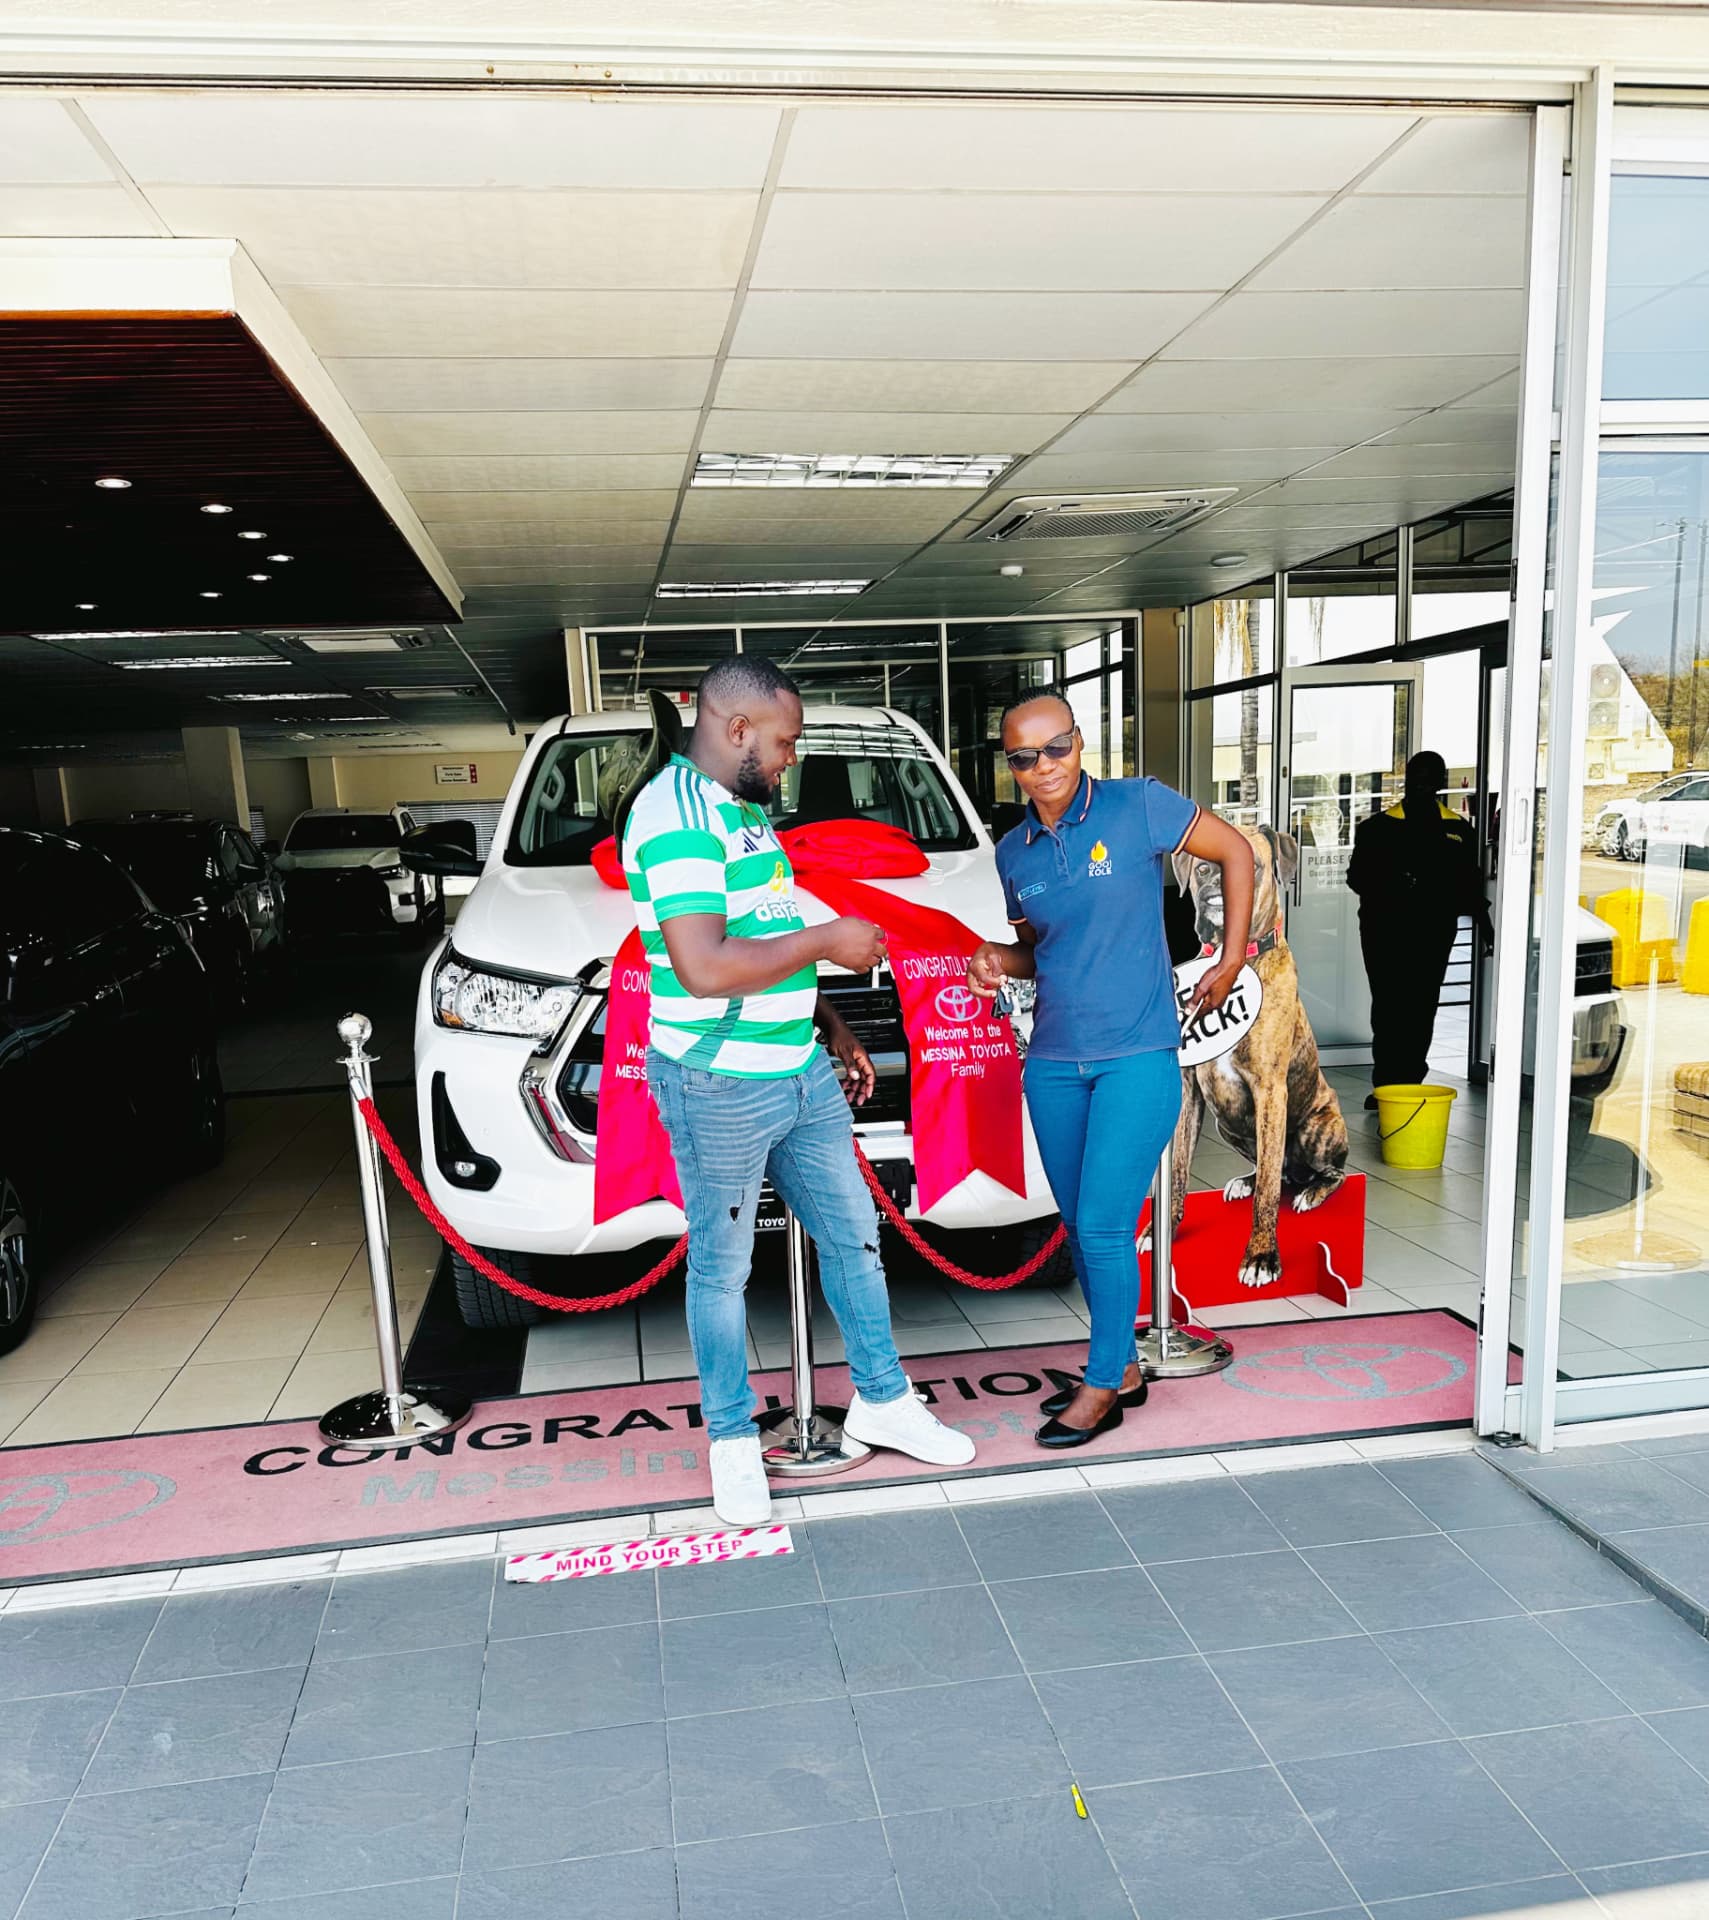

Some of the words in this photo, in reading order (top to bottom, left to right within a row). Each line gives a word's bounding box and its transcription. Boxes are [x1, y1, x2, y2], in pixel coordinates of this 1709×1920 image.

[1308, 855, 1344, 866] PLEASE
[622, 969, 652, 993] CON
[1180, 994, 1250, 1051] ACK!
[925, 1025, 968, 1042] Welcome
[973, 1025, 984, 1039] to
[987, 1023, 1002, 1038] the
[626, 1043, 648, 1060] Wel
[920, 1045, 967, 1063] MESSINA
[970, 1043, 1012, 1060] TOYOTA
[615, 1064, 648, 1080] MESS
[951, 1061, 986, 1079] Family
[756, 1217, 786, 1228] TOYO
[360, 1447, 698, 1506] Messin
[555, 1554, 612, 1572] MIND
[621, 1546, 681, 1564] YOUR
[690, 1539, 744, 1556] STEP
